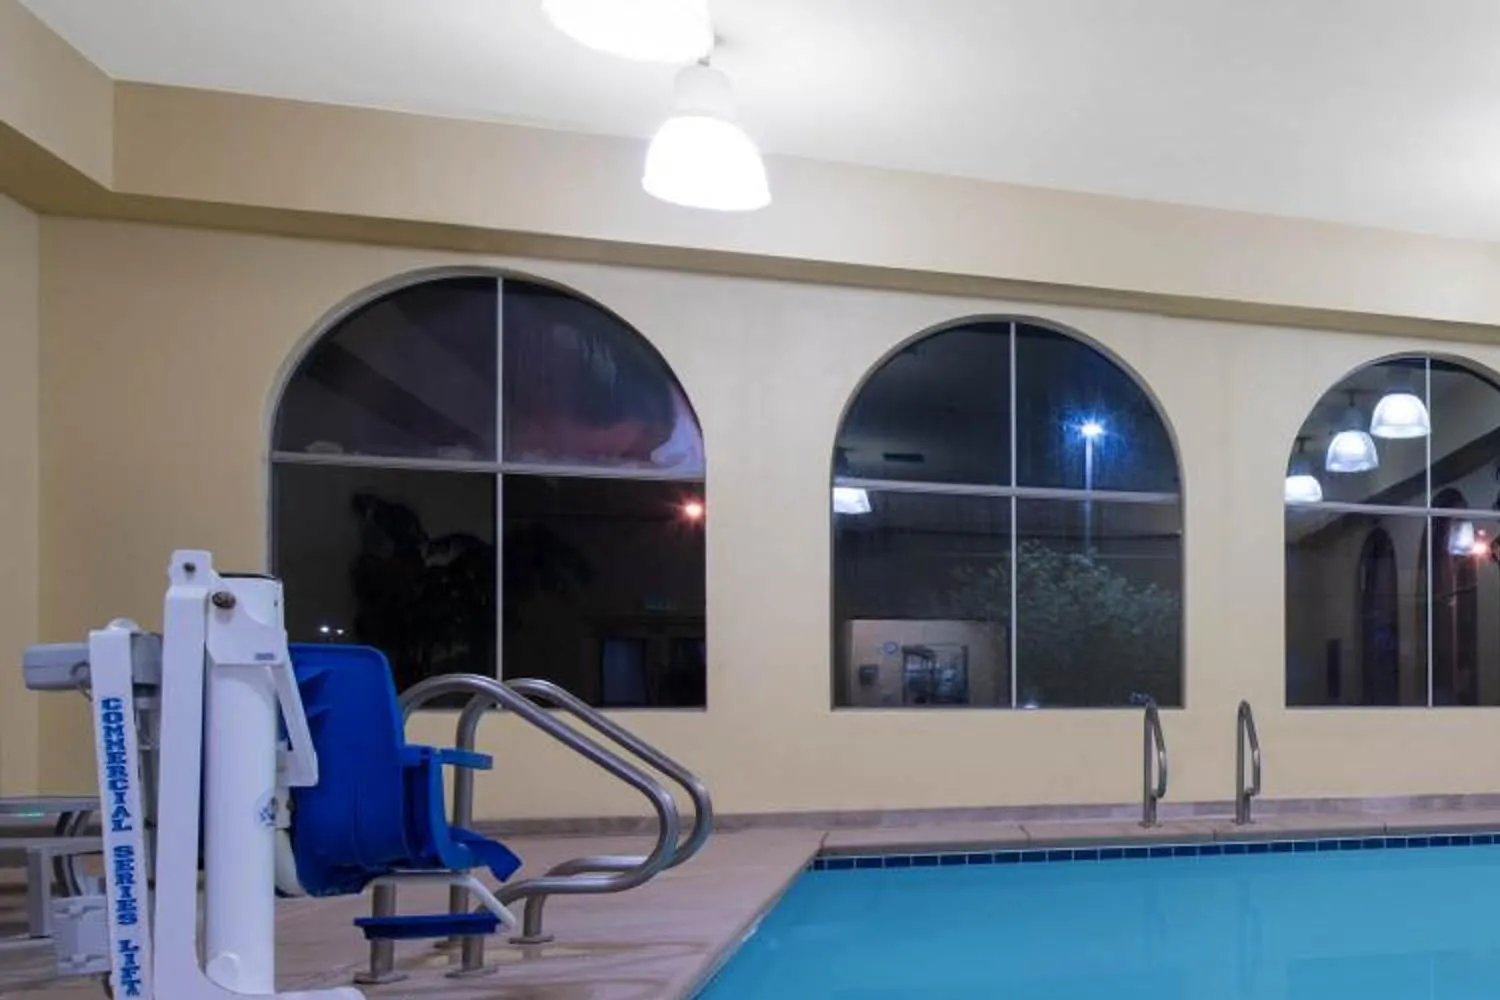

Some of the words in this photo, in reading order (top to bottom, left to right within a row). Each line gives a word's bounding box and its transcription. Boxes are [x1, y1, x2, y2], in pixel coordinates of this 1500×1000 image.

[101, 698, 132, 832] COMMERCIAL
[113, 846, 138, 925] SERIES
[118, 939, 141, 997] LIFT
